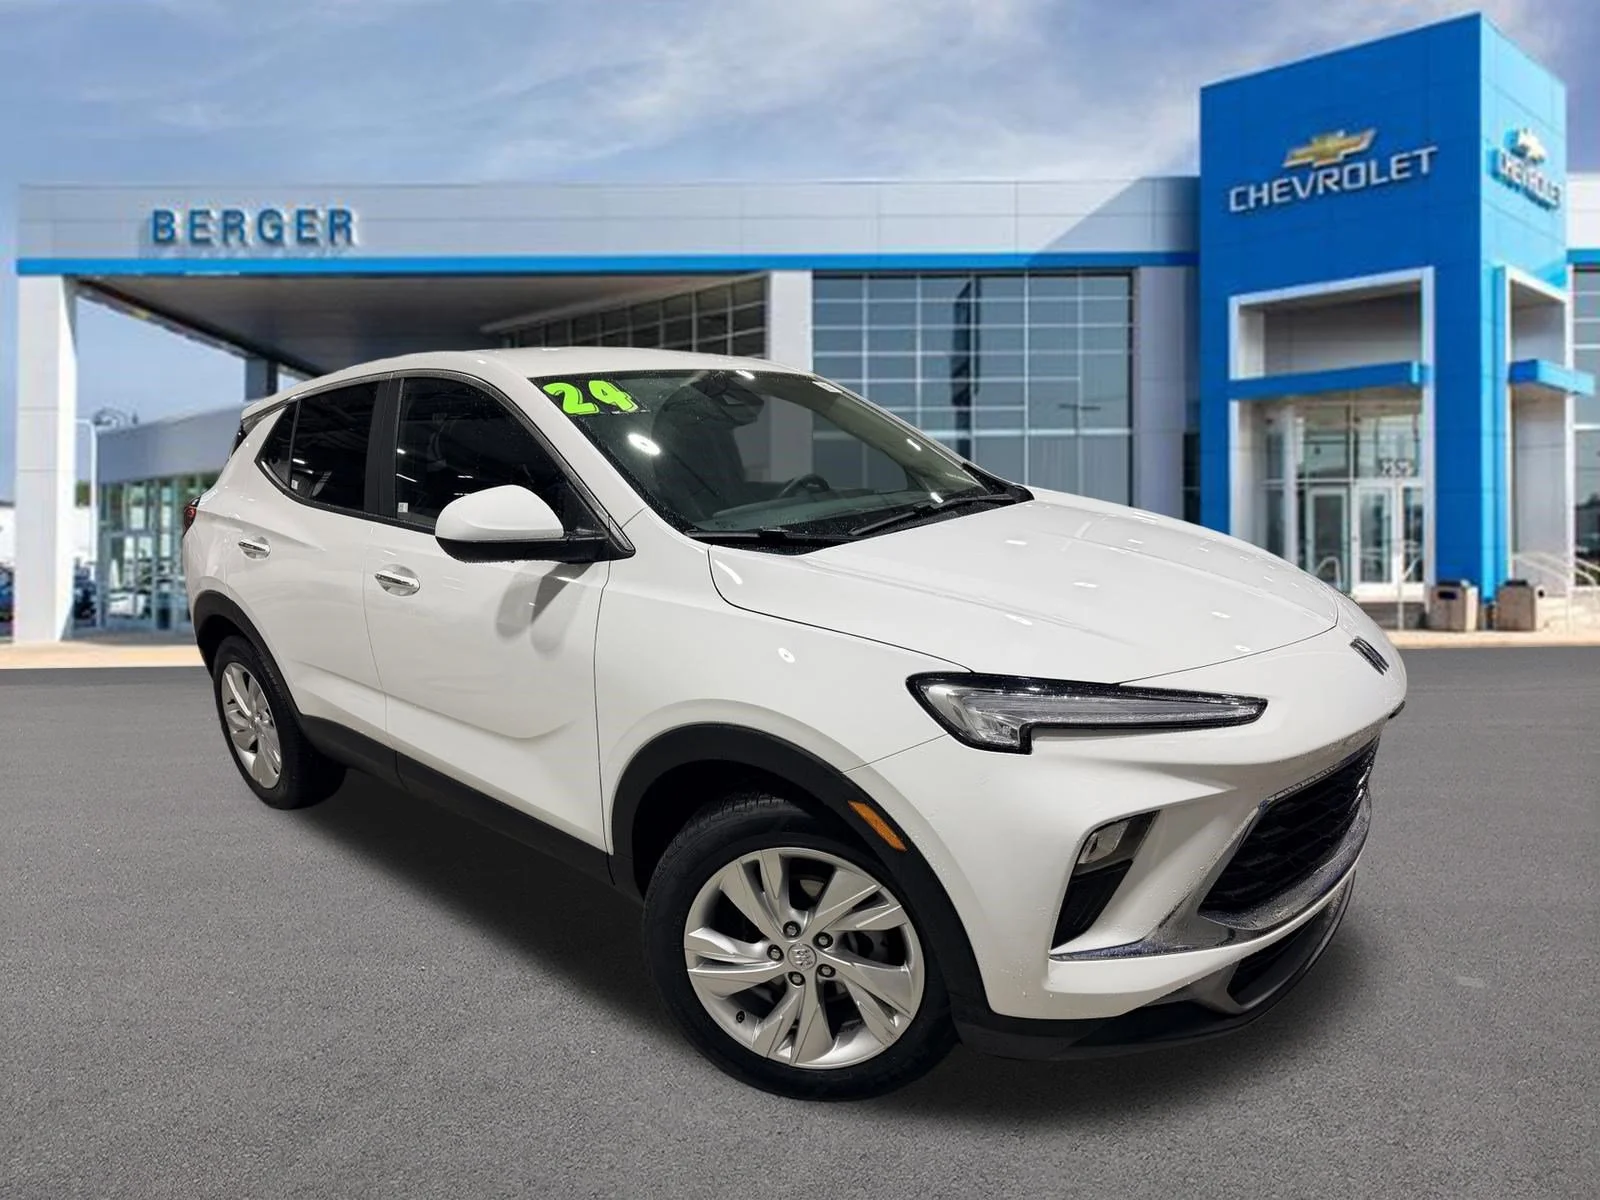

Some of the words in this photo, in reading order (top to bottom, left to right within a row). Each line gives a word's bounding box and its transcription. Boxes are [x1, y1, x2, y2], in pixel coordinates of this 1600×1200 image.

[1228, 145, 1438, 213] CHEVROLET
[152, 207, 356, 246] BERGER
[541, 379, 639, 415] 24
